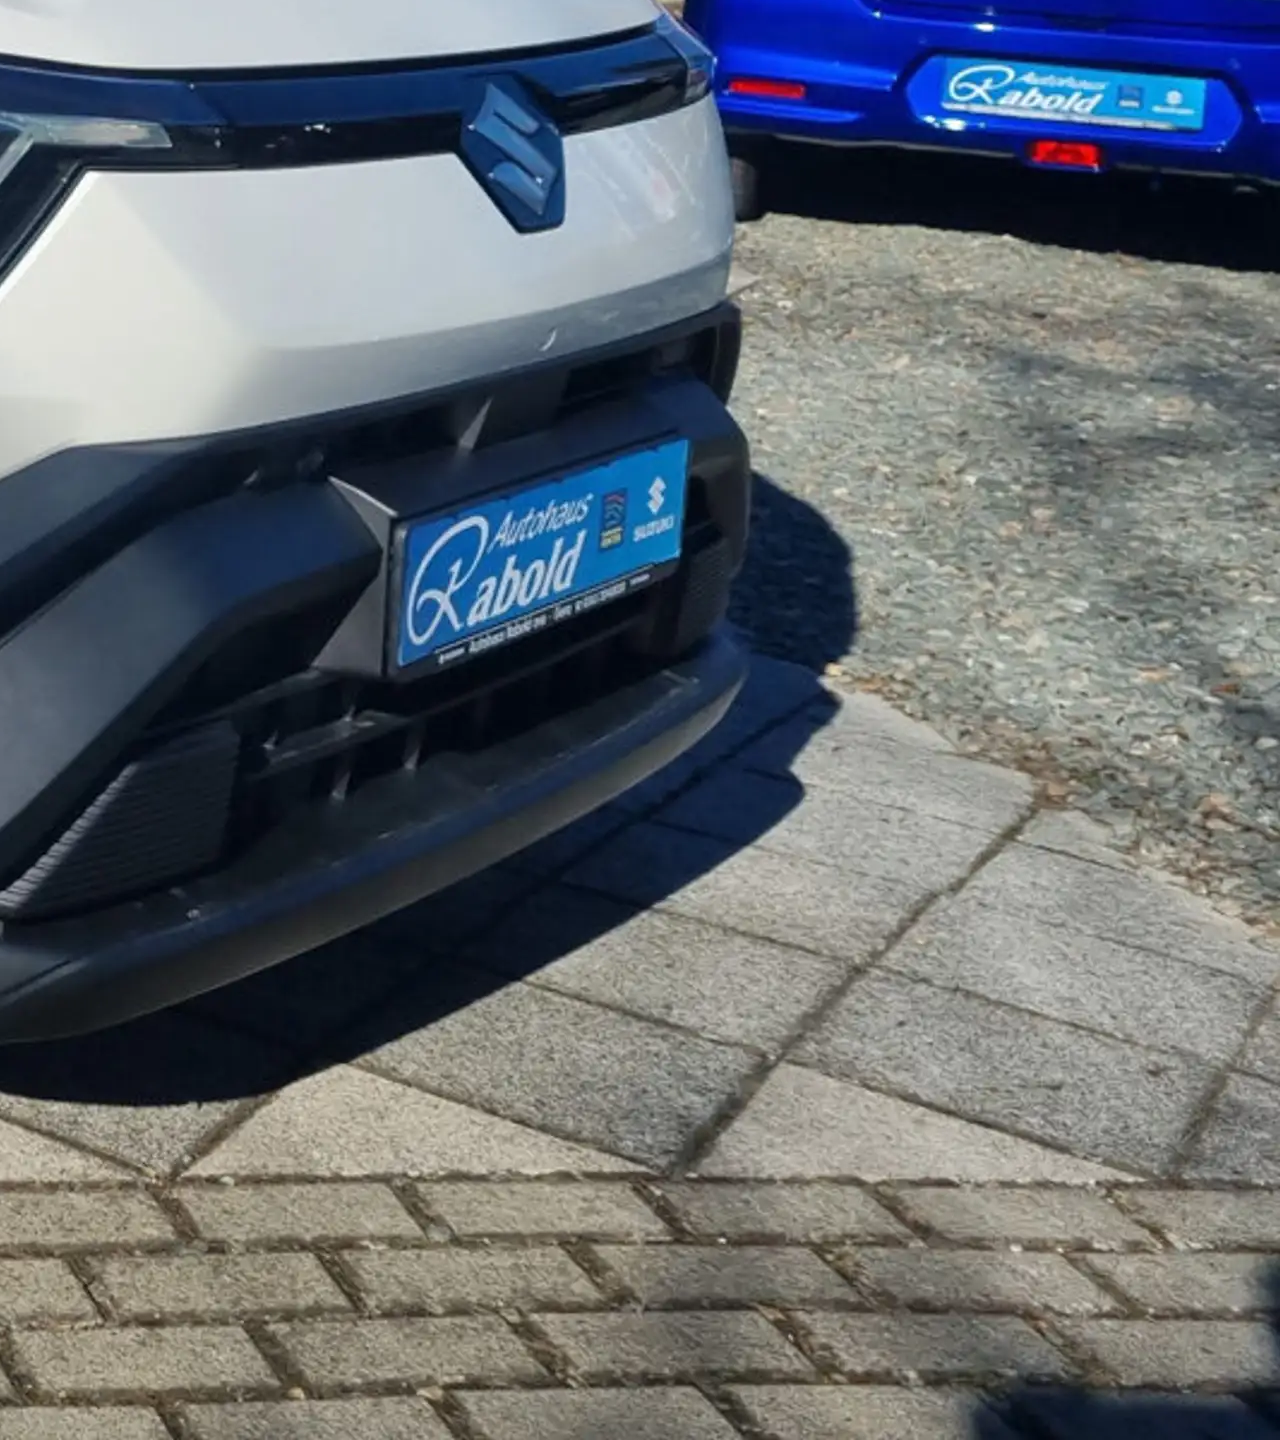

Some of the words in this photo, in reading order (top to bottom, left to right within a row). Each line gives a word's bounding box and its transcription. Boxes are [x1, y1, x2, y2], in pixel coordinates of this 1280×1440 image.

[948, 64, 1103, 115] Rabold
[486, 492, 594, 553] Autohaus
[406, 514, 587, 646] Rabold
